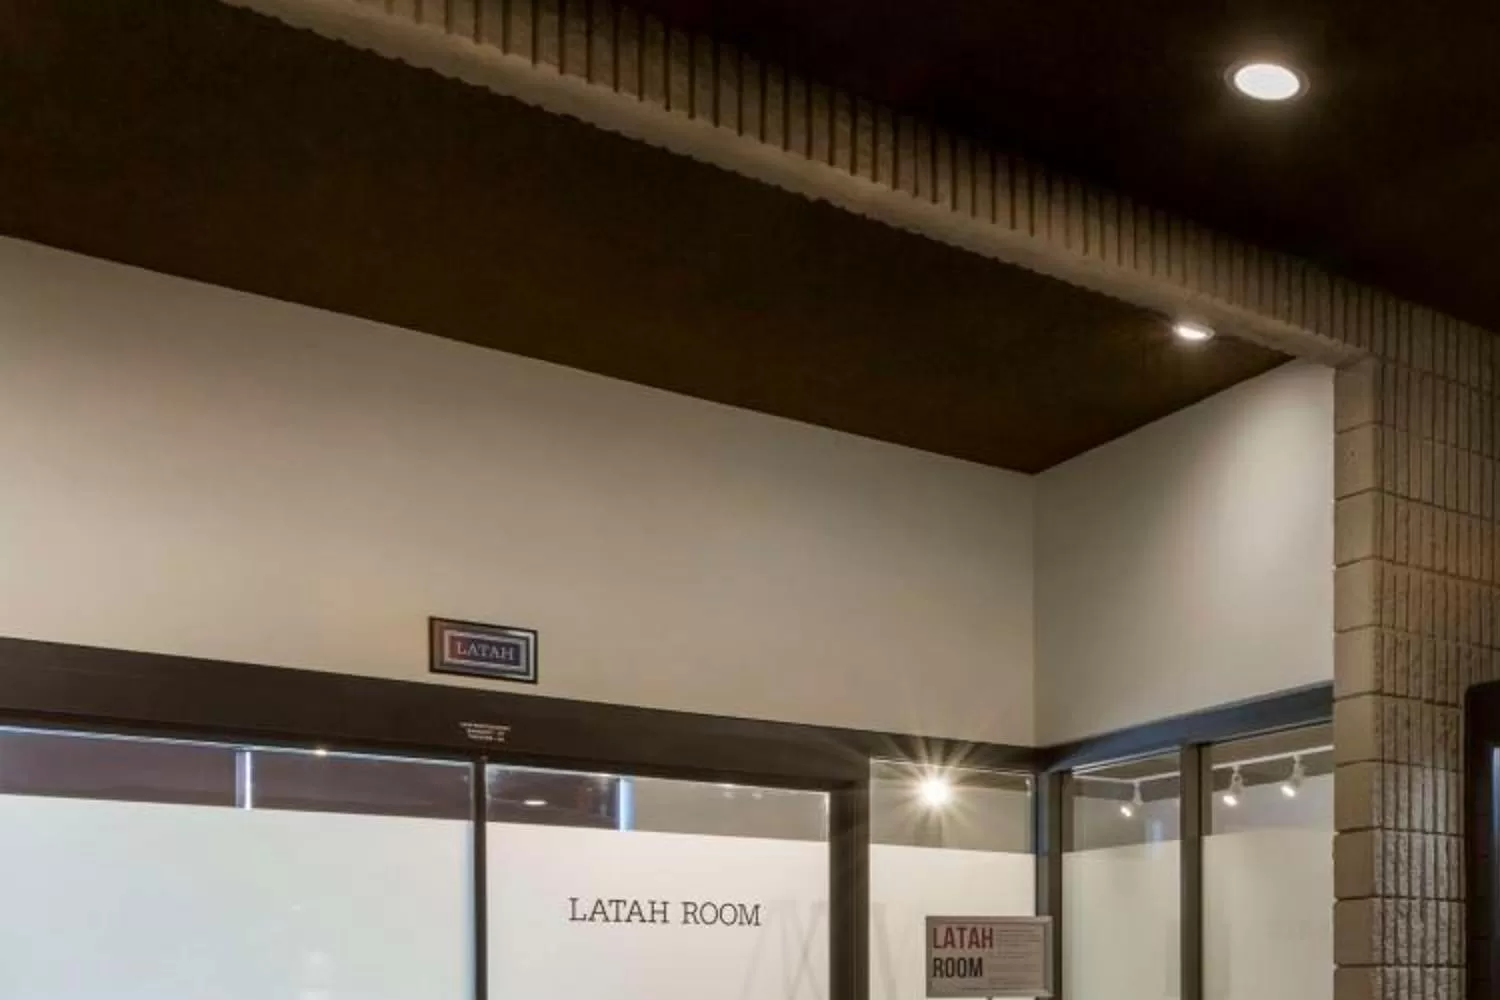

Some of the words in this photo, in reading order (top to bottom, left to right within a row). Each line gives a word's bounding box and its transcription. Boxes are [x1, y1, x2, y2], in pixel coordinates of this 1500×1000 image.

[456, 641, 514, 661] LATAH
[567, 897, 670, 924] LATAH
[681, 901, 761, 927] ROOM
[932, 926, 994, 949] LATAH
[932, 956, 984, 978] ROOM
